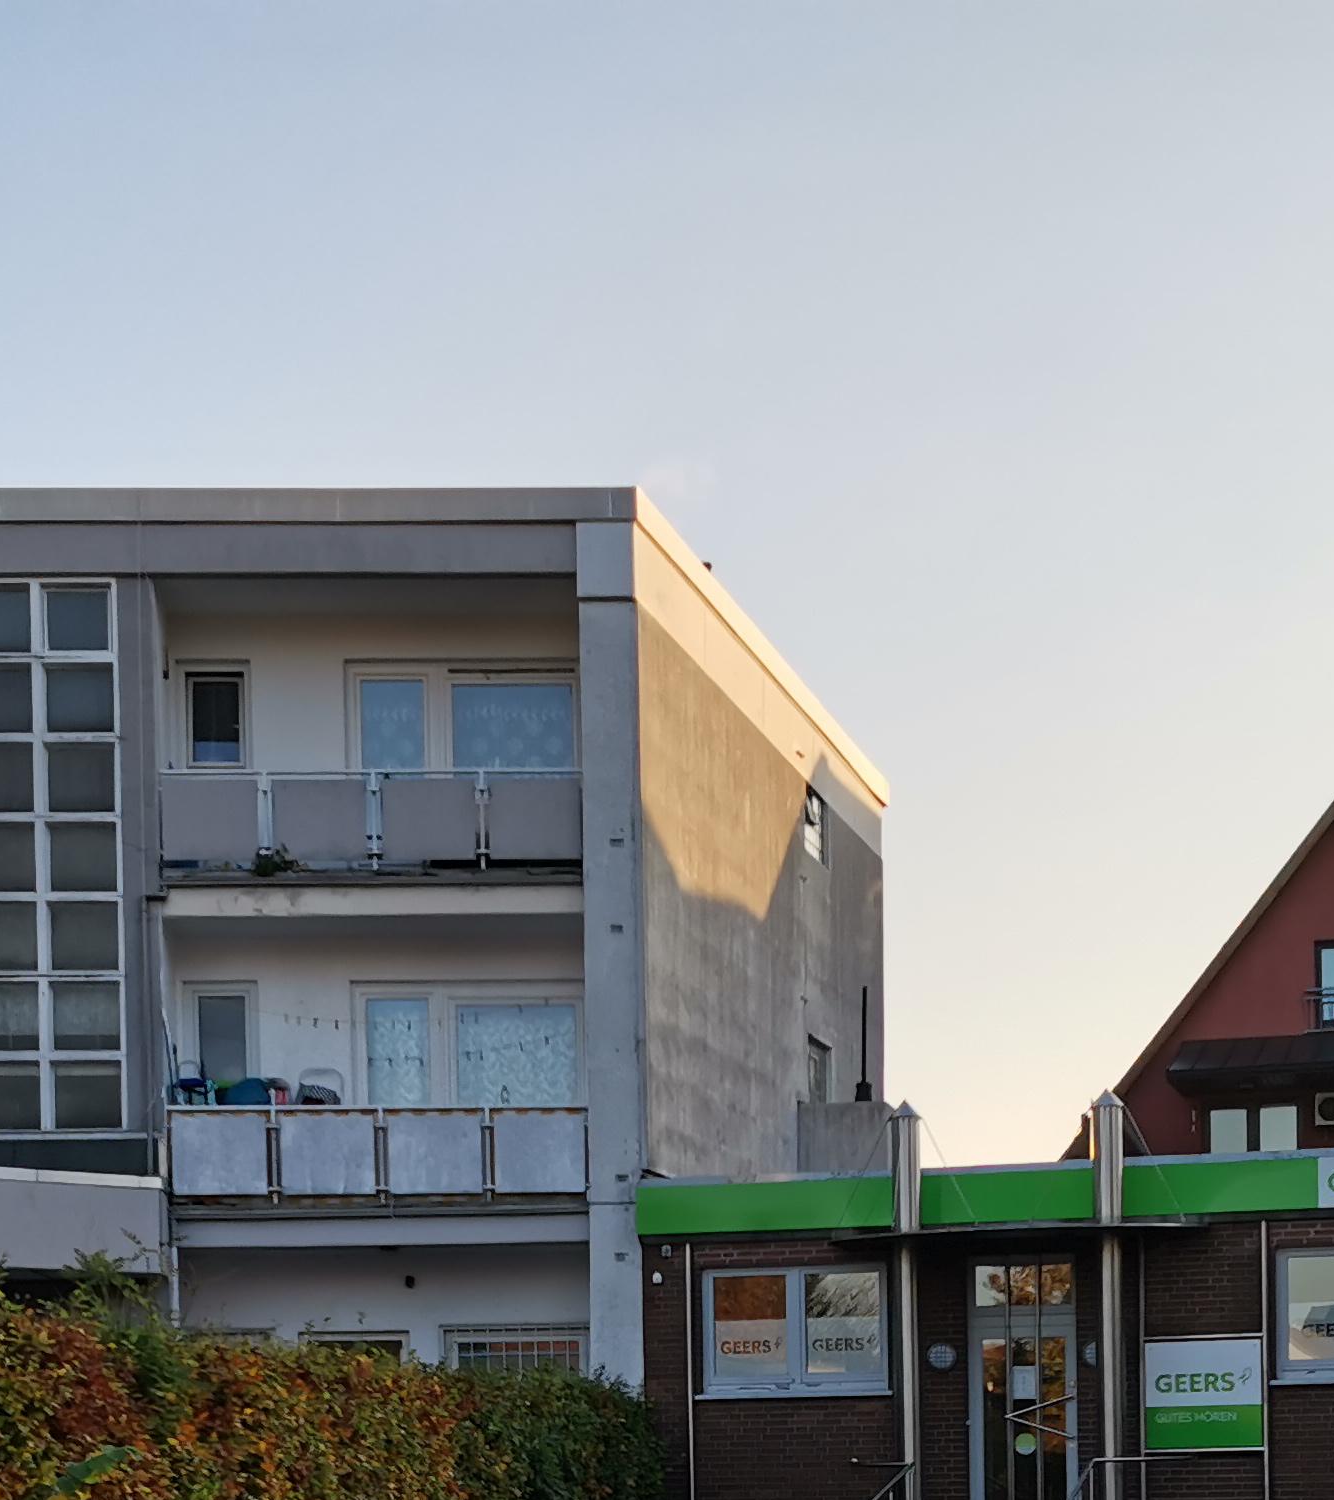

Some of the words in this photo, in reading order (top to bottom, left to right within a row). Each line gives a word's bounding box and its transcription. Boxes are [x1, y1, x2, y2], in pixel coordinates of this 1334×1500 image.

[720, 1339, 772, 1355] GEERS
[812, 1337, 865, 1353] GEERS
[1154, 1371, 1236, 1394] GEERS
[1154, 1411, 1193, 1424] GUTES
